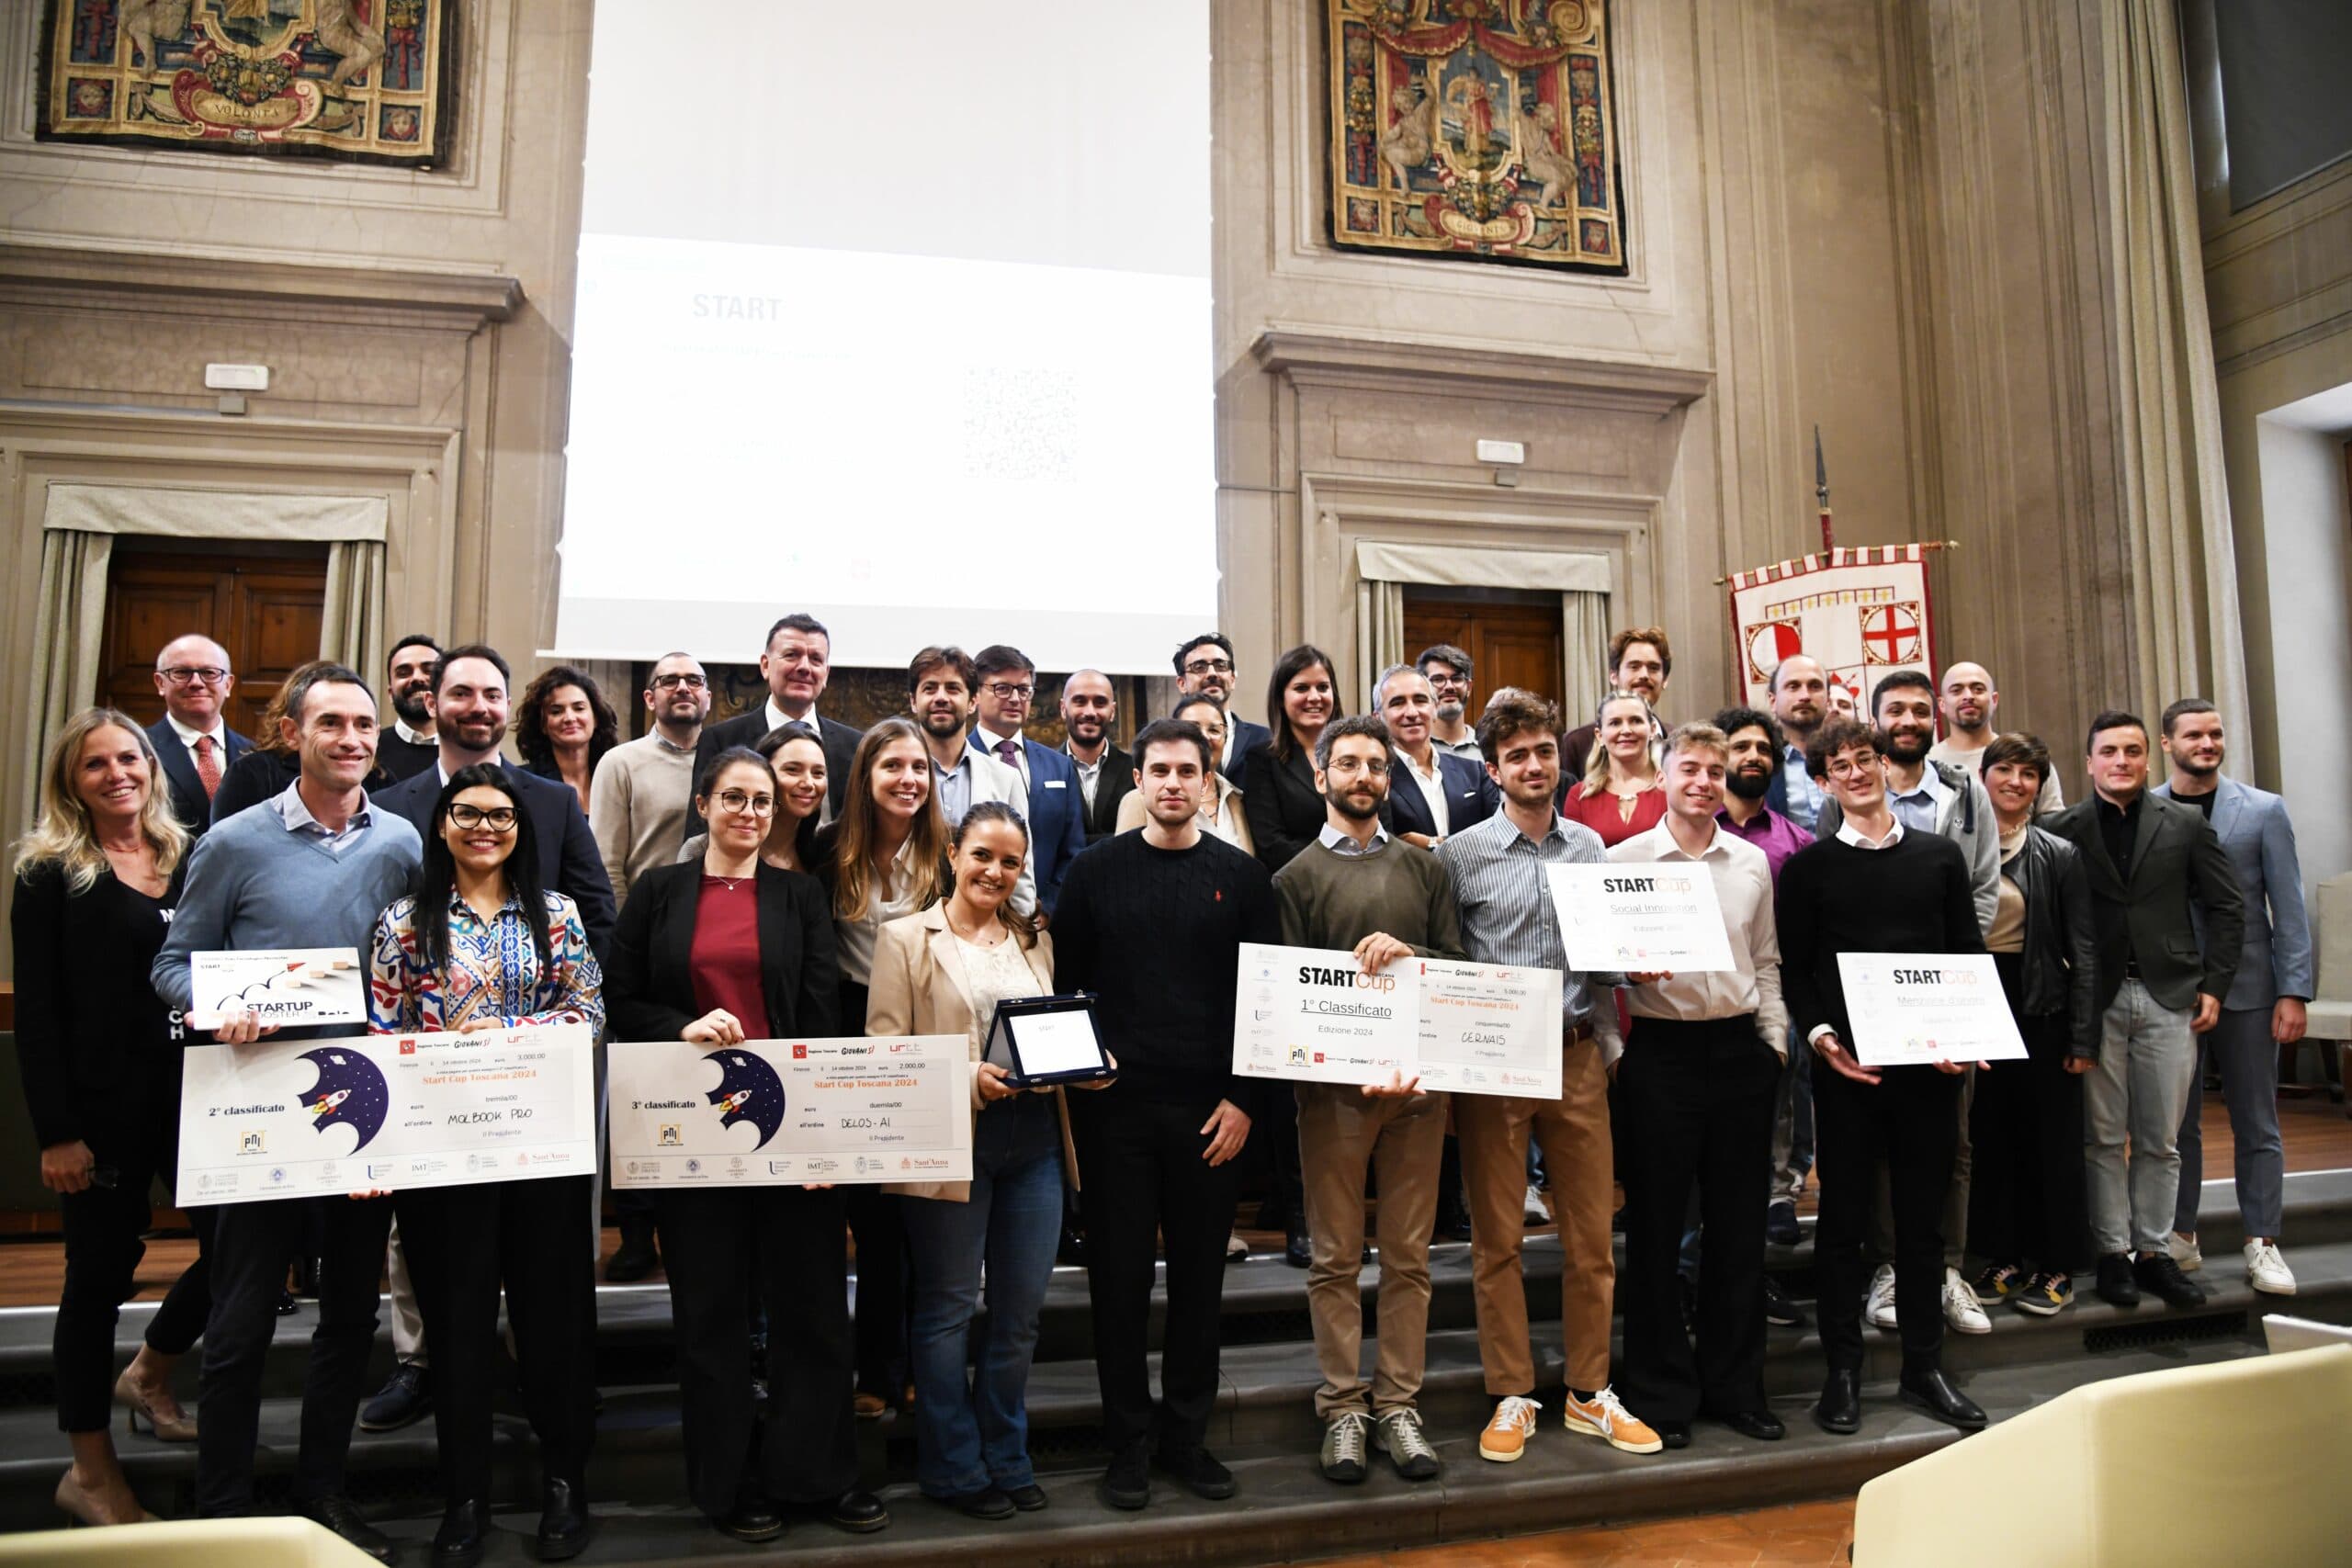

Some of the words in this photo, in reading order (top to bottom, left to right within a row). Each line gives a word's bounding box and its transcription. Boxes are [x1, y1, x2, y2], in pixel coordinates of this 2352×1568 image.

[691, 293, 785, 321] START
[1610, 904, 1641, 912] Social
[247, 1001, 313, 1014] STARTUP
[1318, 1000, 1392, 1017] Classificato
[1317, 1025, 1351, 1034] Edizione
[1353, 1027, 1374, 1036] 2024
[423, 1074, 447, 1086] Start
[448, 1074, 468, 1085] Cup
[470, 1072, 509, 1082] Toscana
[512, 1069, 537, 1080] 2024
[814, 1079, 835, 1089] Start
[837, 1079, 855, 1090] Cup
[856, 1079, 892, 1089] Toscana
[894, 1077, 919, 1088] 2024
[209, 1106, 220, 1117] 2°
[224, 1103, 285, 1116] classificato
[631, 1100, 642, 1110] 3°
[644, 1100, 696, 1110] classificato
[511, 1108, 533, 1121] PRO
